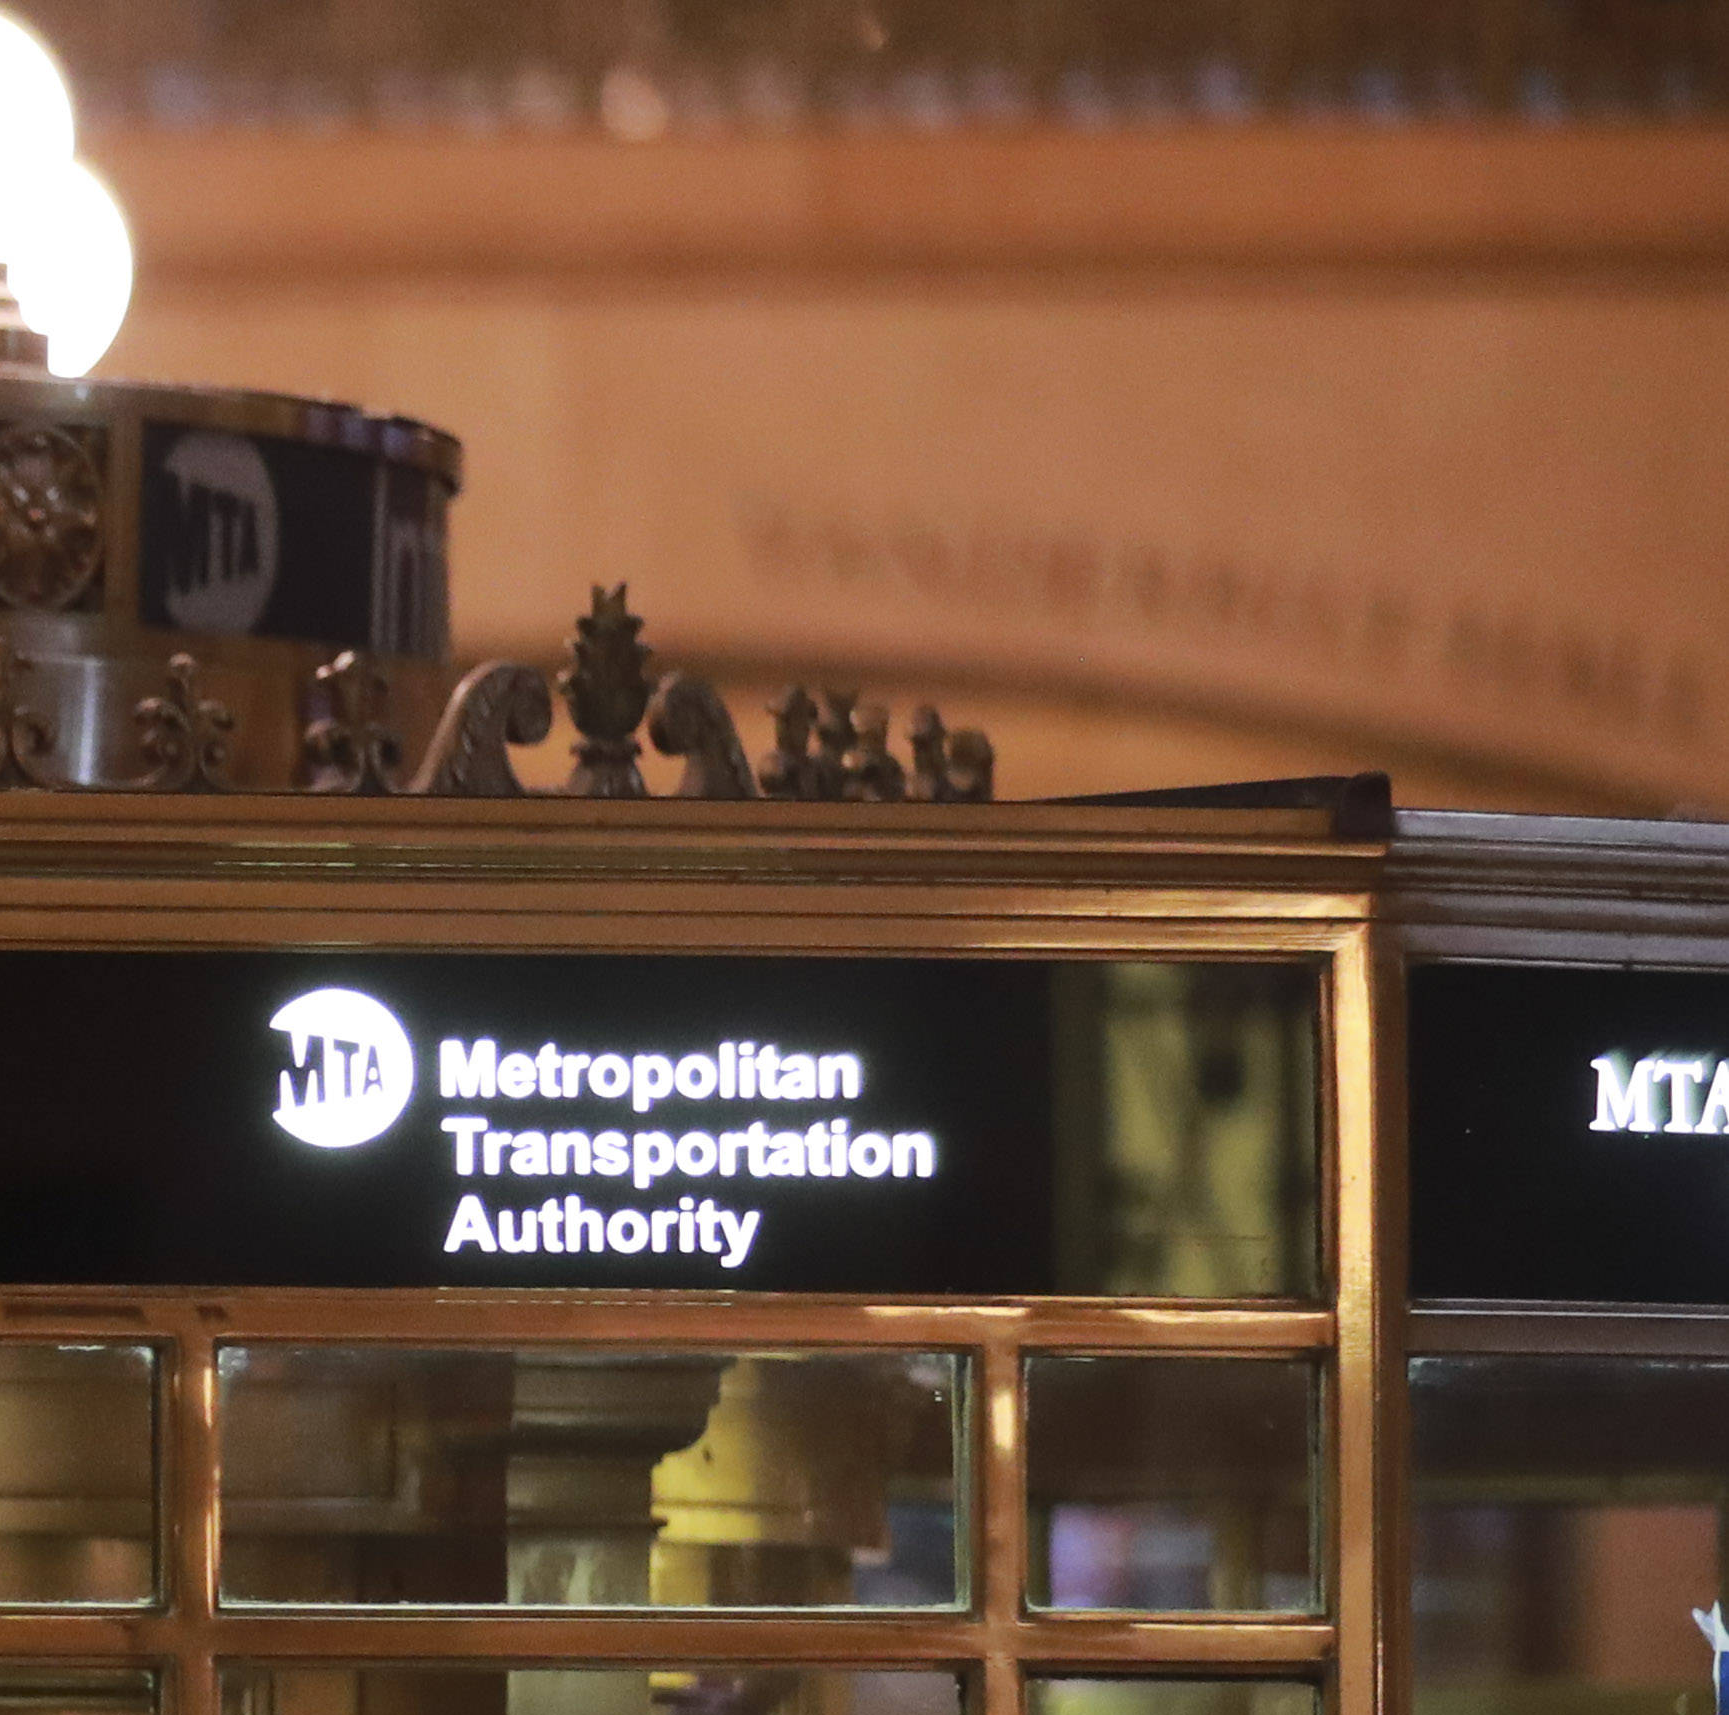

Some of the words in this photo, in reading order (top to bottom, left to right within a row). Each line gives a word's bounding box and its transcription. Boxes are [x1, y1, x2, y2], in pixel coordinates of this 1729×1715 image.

[439, 1038, 861, 1113] Metropolitan
[1588, 1056, 1729, 1135] MTA
[439, 1116, 937, 1189] Transportation
[443, 1194, 762, 1269] Authority
